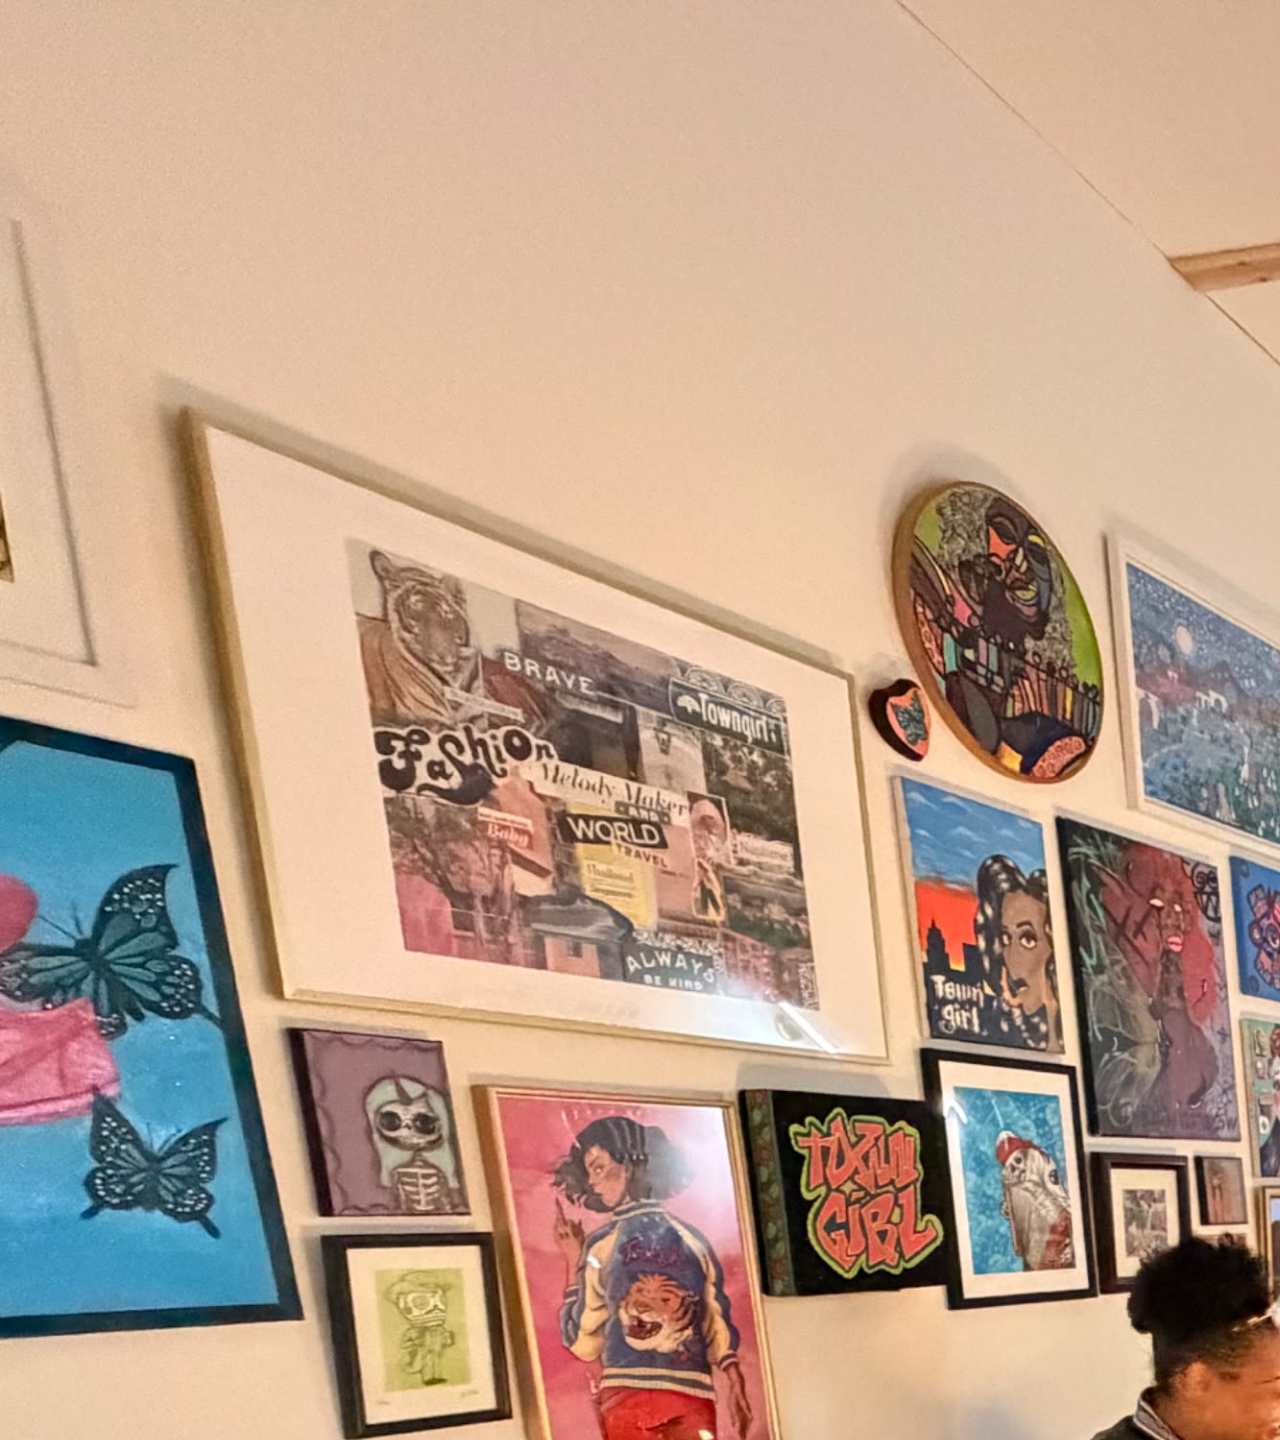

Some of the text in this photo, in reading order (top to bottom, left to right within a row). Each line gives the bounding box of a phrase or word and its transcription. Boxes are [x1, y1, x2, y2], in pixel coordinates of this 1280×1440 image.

[503, 651, 595, 695] BRAVE
[542, 763, 688, 816] Melody Maker
[566, 815, 660, 844] WORLD
[614, 842, 668, 868] TRAVEL
[625, 950, 715, 982] ALWAYS
[939, 1003, 980, 1034] girl
